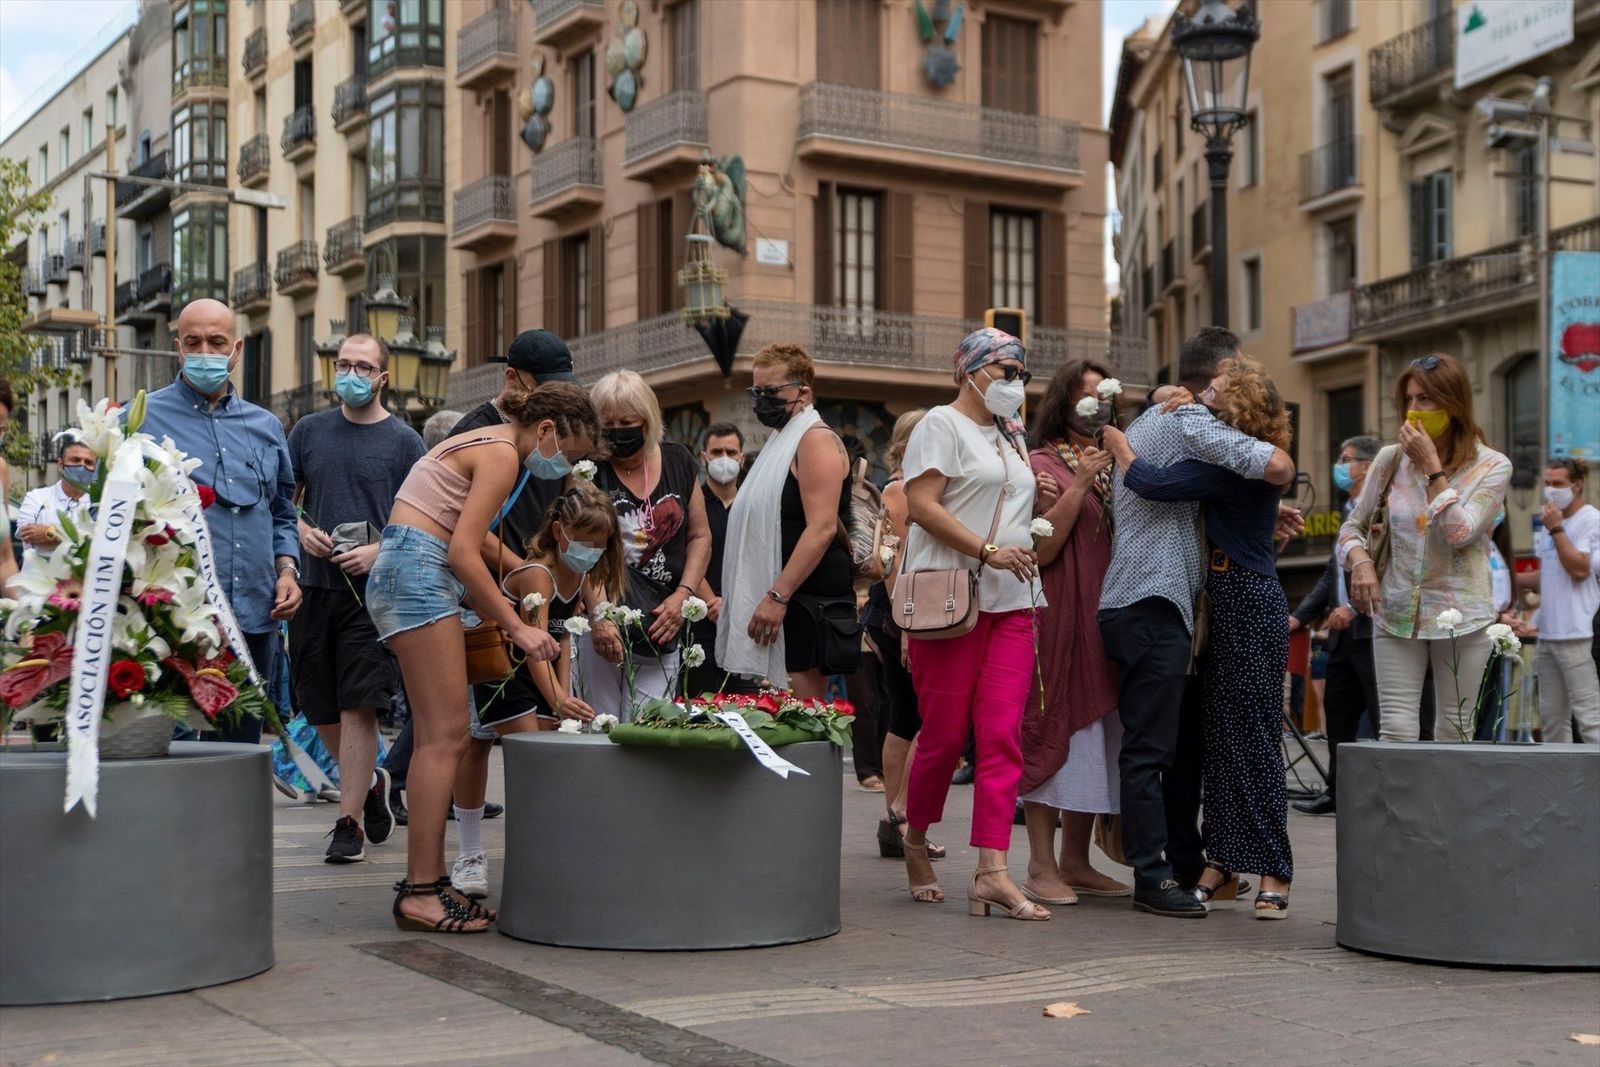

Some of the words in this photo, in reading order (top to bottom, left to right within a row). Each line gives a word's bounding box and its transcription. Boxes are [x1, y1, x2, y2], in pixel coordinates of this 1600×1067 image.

[77, 601, 108, 738] ASOCIACIÓN
[94, 555, 115, 594] 11M
[105, 498, 128, 542] CON
